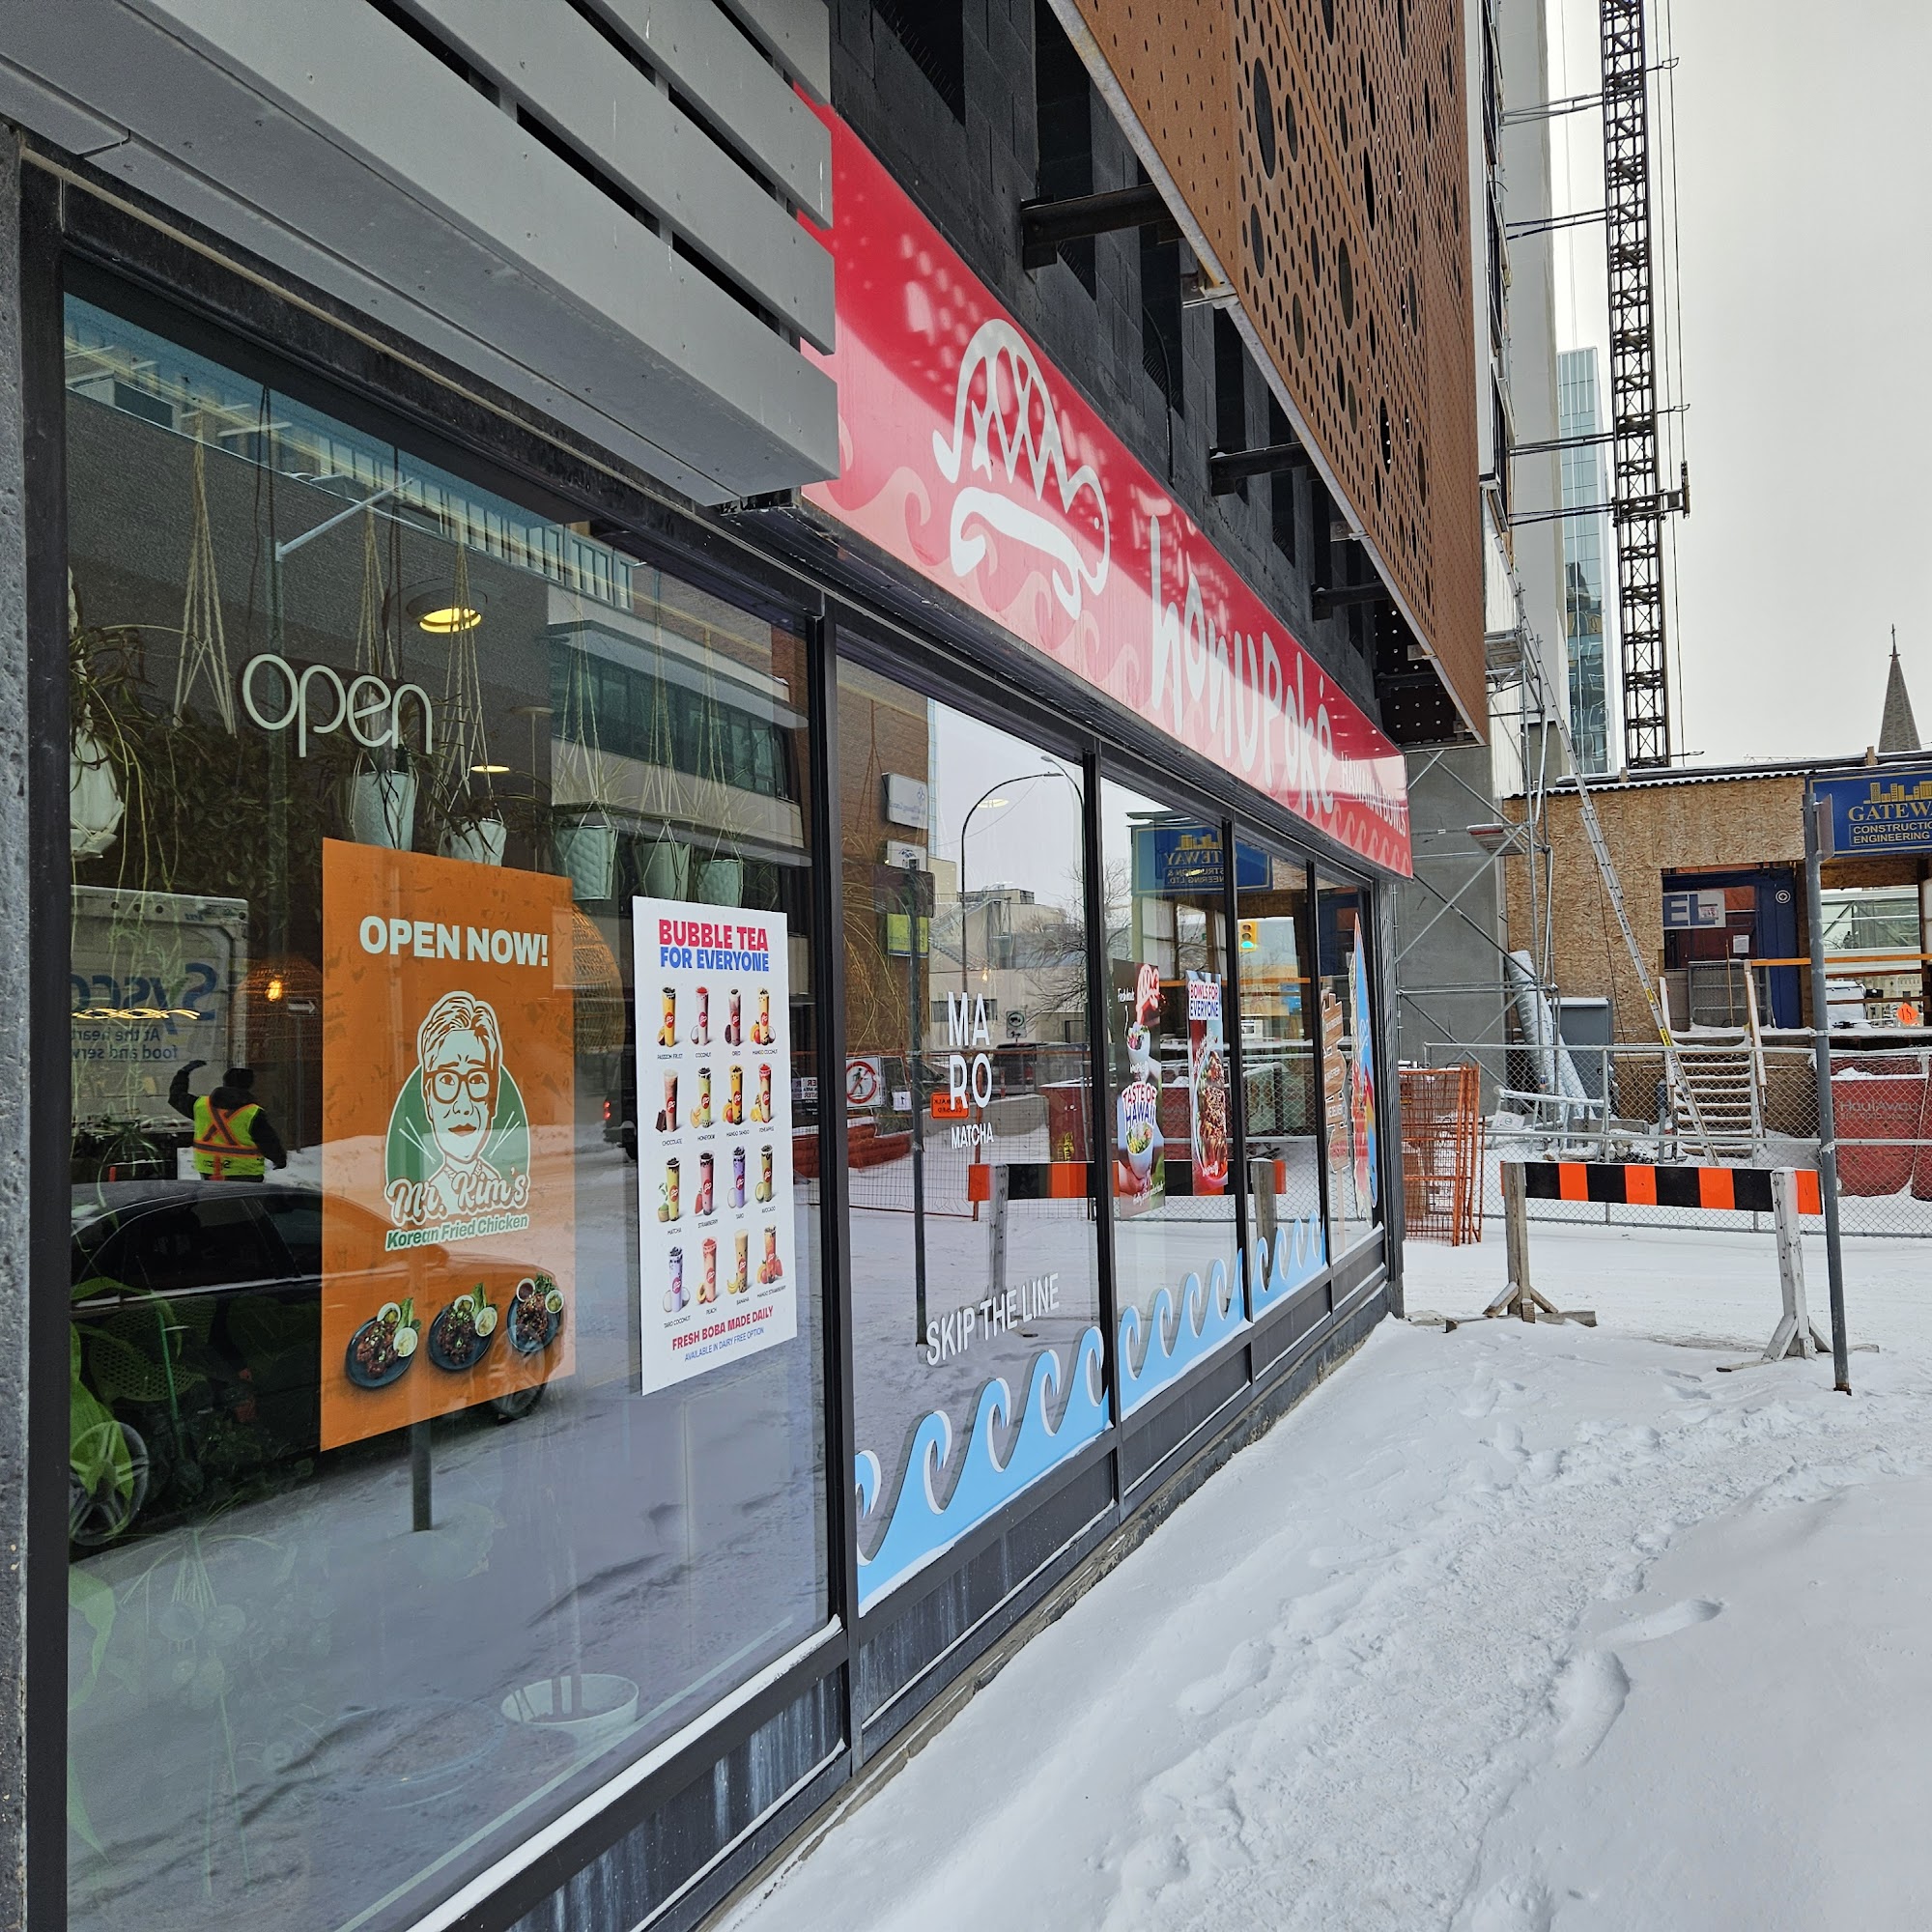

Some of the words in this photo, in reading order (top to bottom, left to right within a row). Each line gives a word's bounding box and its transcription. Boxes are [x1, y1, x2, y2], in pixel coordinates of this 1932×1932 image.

[242, 652, 433, 758] open
[1341, 751, 1382, 818] HAWAIIAN
[1382, 788, 1406, 838] BOWLS
[1848, 800, 1932, 823] GATEW
[1853, 831, 1930, 844] ENGINEERING
[358, 915, 460, 960] OPEN
[467, 926, 549, 967] NOW!
[658, 919, 733, 950] BUBBLE
[736, 925, 769, 952] TEA
[660, 947, 693, 969] FOR
[696, 949, 770, 972] EVERYONE
[1190, 984, 1208, 1001] BOWLS
[1208, 985, 1219, 1000] FOR
[1190, 1001, 1219, 1017] EVERYONE
[947, 991, 991, 1047] MA
[949, 1052, 993, 1111] RO
[1122, 1084, 1146, 1106] TASTE
[1146, 1086, 1156, 1103] OF
[1125, 1102, 1156, 1127] HAWAII
[951, 1122, 995, 1150] MATCHA
[386, 1177, 447, 1226] Mr.
[452, 1167, 528, 1211] Kim's
[386, 1224, 440, 1250] Korean
[440, 1219, 476, 1242] Fried
[476, 1213, 528, 1236] Chicken
[671, 1329, 700, 1350] FRESH
[701, 1322, 726, 1341] BOBA
[727, 1313, 752, 1331] MADE
[751, 1305, 774, 1324] DAILY
[925, 1306, 976, 1367] SKIP
[980, 1289, 1018, 1341] THE
[1022, 1272, 1059, 1323] LINE
[684, 1345, 713, 1362] AVAILABLE
[712, 1342, 719, 1351] IN
[719, 1336, 734, 1350] DAIRY
[734, 1332, 747, 1345] FREE
[747, 1326, 764, 1340] OPTION
